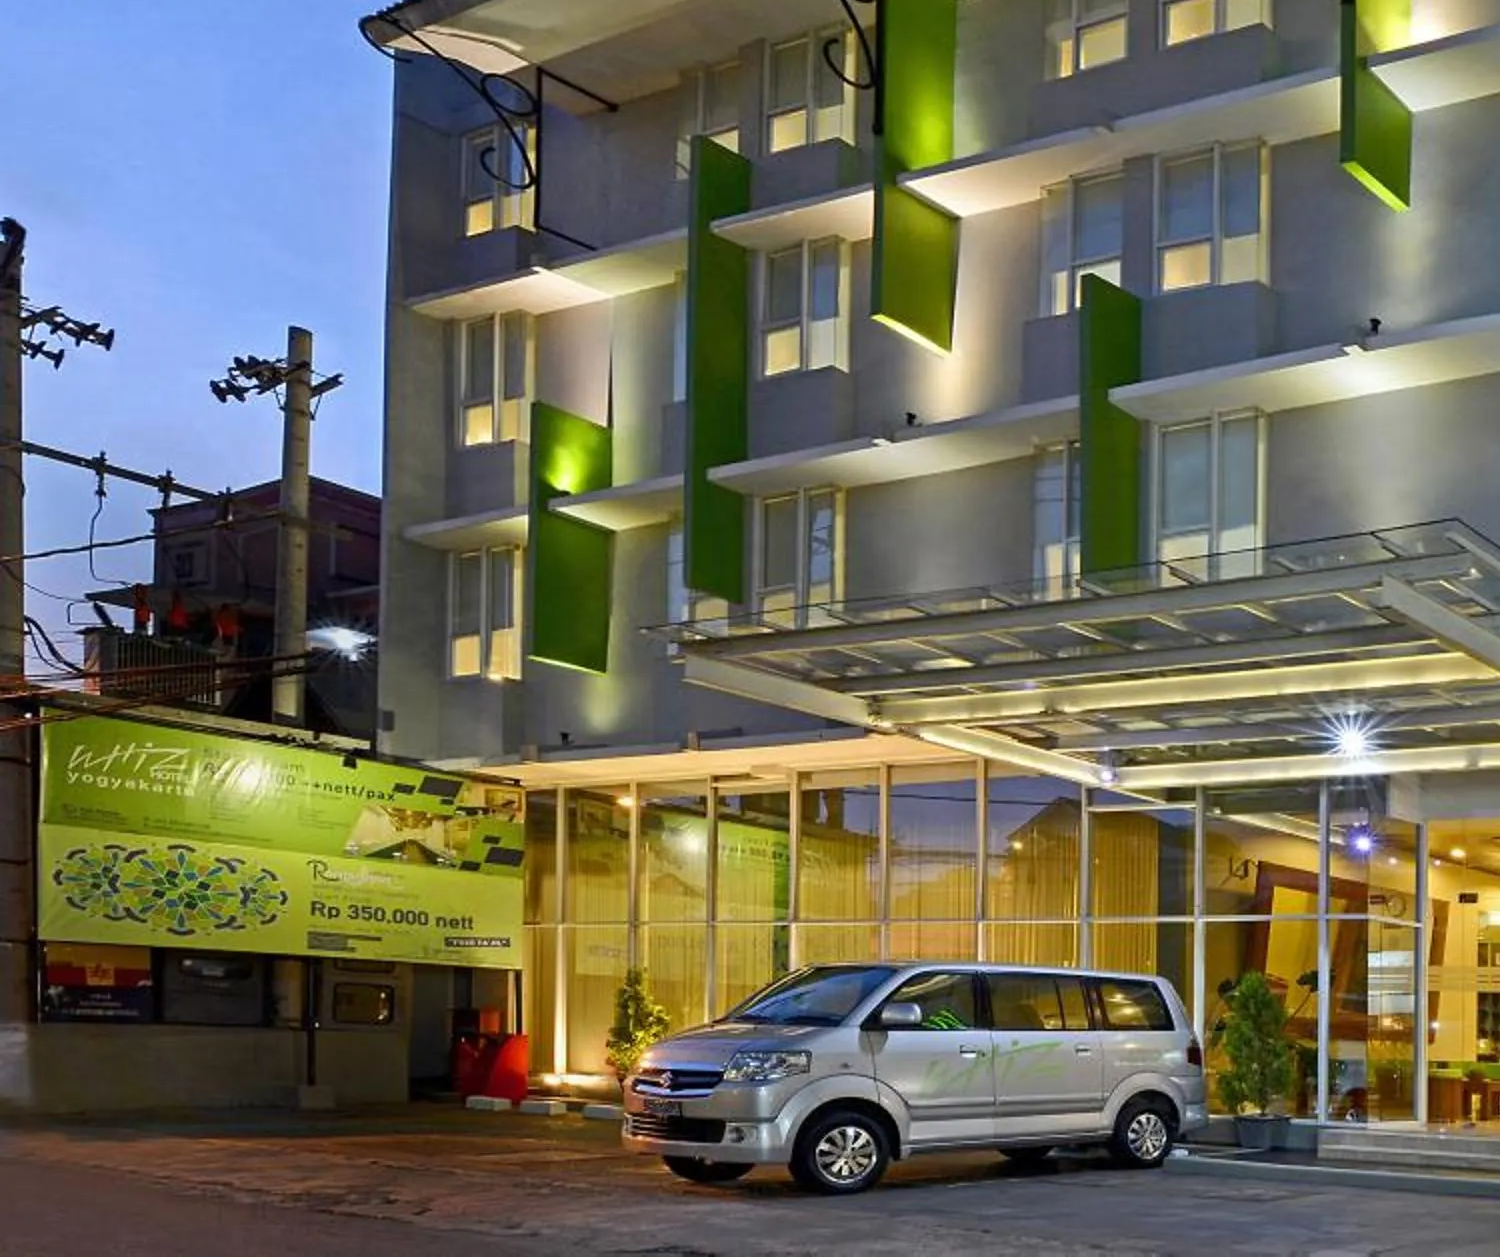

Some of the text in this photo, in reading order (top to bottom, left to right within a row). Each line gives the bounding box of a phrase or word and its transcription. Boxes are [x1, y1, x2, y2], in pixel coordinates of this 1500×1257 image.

[66, 770, 196, 797] yogyakarta
[310, 900, 474, 930] Rp 350.000 nett
